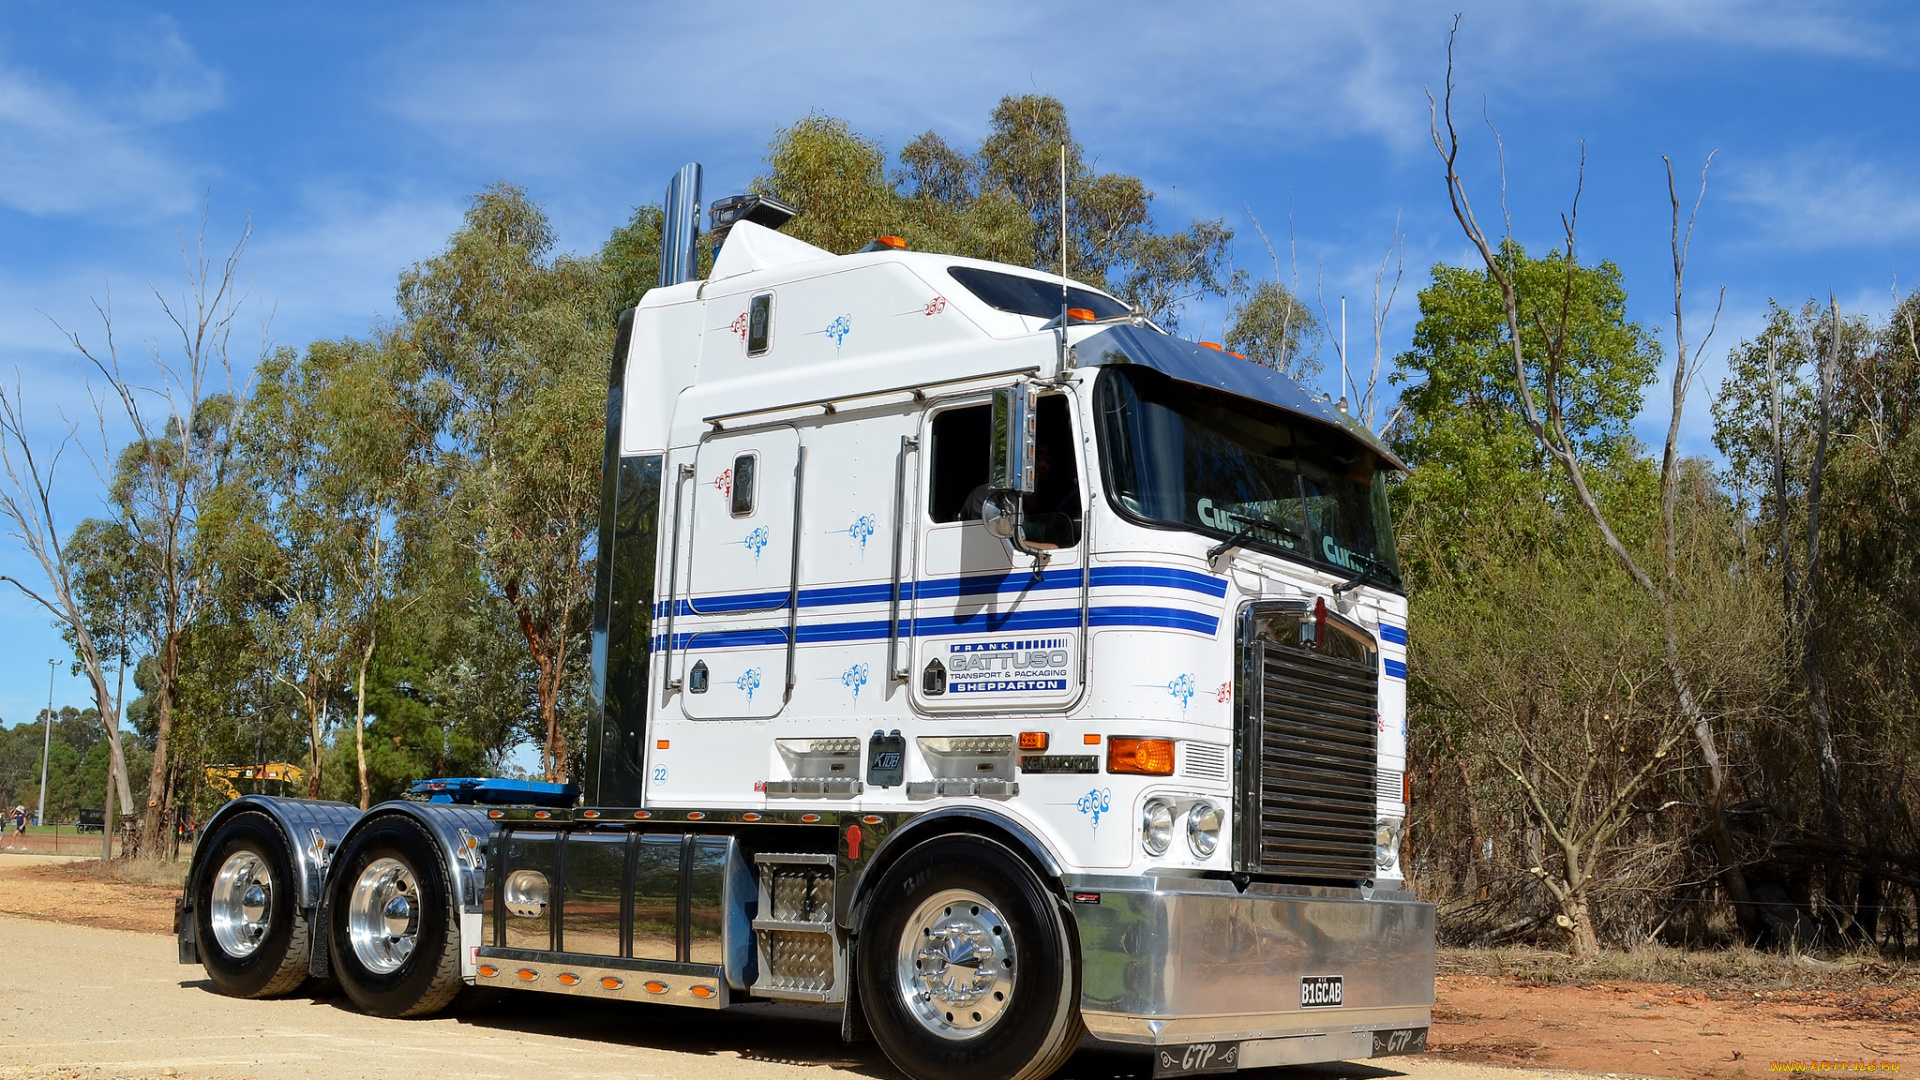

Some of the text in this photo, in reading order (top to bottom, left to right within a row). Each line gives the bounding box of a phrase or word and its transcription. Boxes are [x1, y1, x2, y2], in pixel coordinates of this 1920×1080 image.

[954, 642, 1009, 652] FRANK
[949, 650, 1068, 671] GATTUSO
[950, 672, 1001, 680] TRANSPORT
[1014, 669, 1067, 677] PACKAGING
[957, 680, 1058, 692] SHEPPARTON
[1022, 756, 1098, 770] KENWORTH
[654, 768, 666, 781] 22
[1302, 982, 1342, 1004] B1GCAB
[1387, 1030, 1412, 1052] GTP
[1182, 1043, 1217, 1070] GTP
